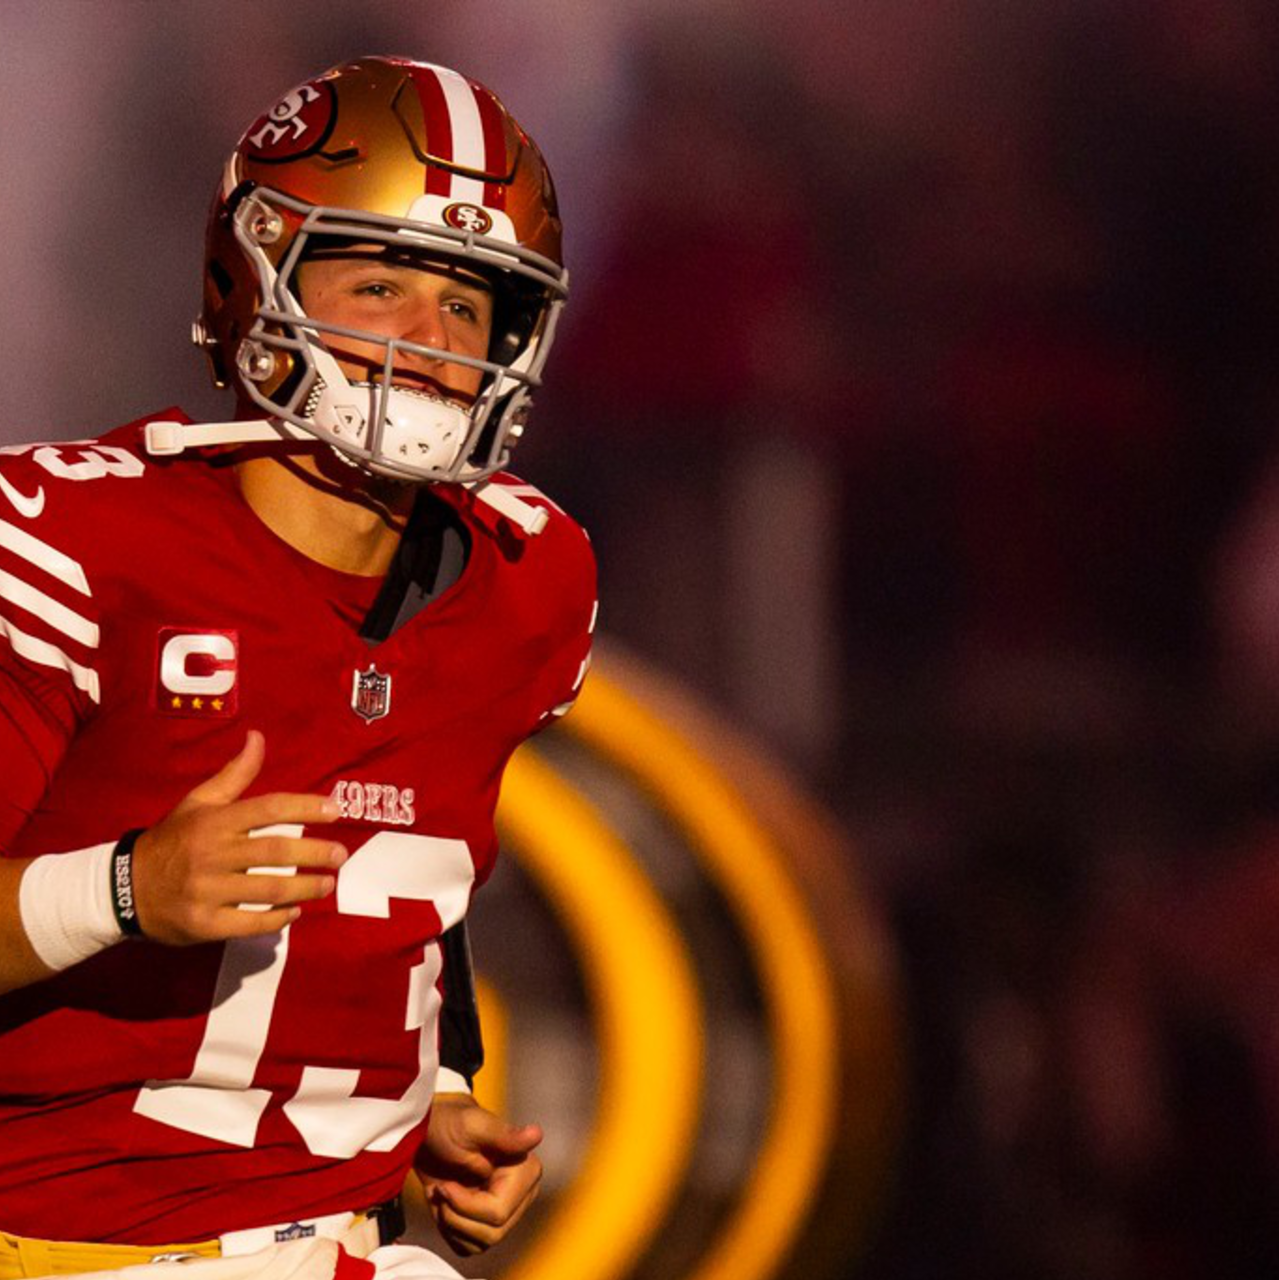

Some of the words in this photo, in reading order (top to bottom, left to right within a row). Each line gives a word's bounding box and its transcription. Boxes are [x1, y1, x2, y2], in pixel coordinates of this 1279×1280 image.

[161, 634, 236, 695] C
[327, 780, 416, 827] 49ERS
[132, 823, 476, 1160] 13
